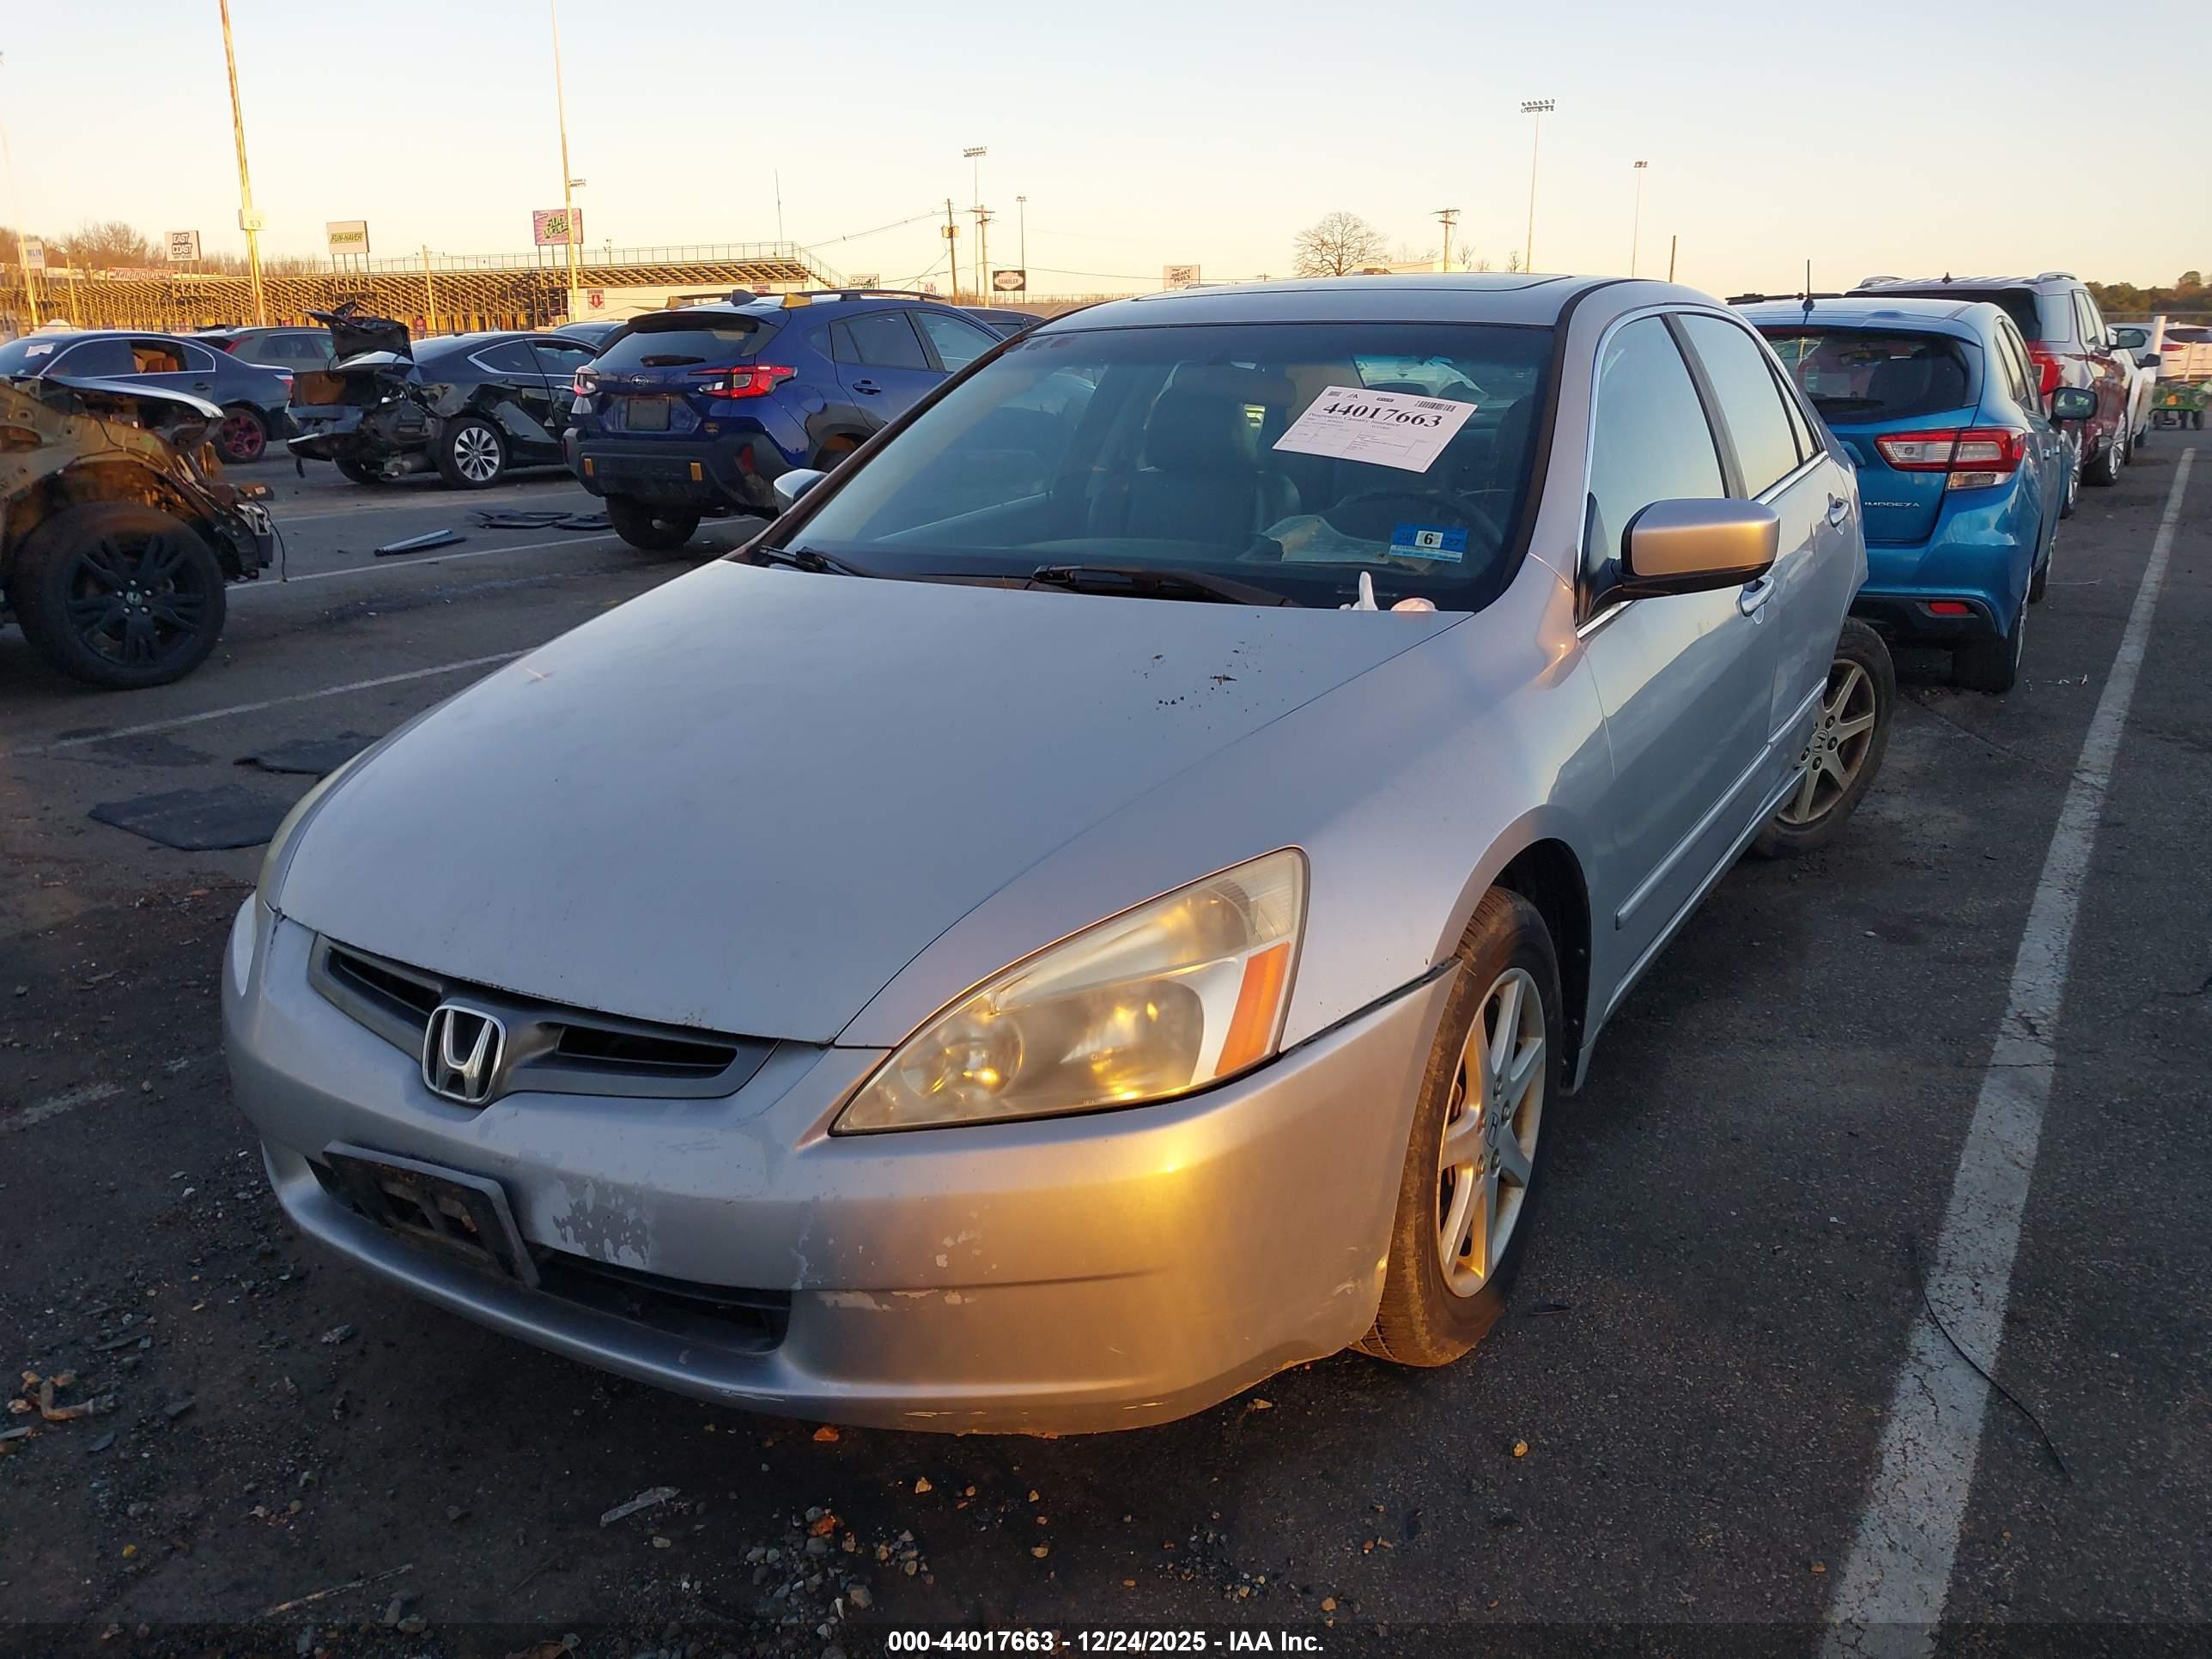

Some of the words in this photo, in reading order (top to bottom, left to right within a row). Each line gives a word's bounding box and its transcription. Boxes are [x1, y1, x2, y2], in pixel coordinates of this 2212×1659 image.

[173, 233, 190, 245] EAST
[1322, 402, 1443, 428] 44017663
[1424, 533, 1434, 545] 6
